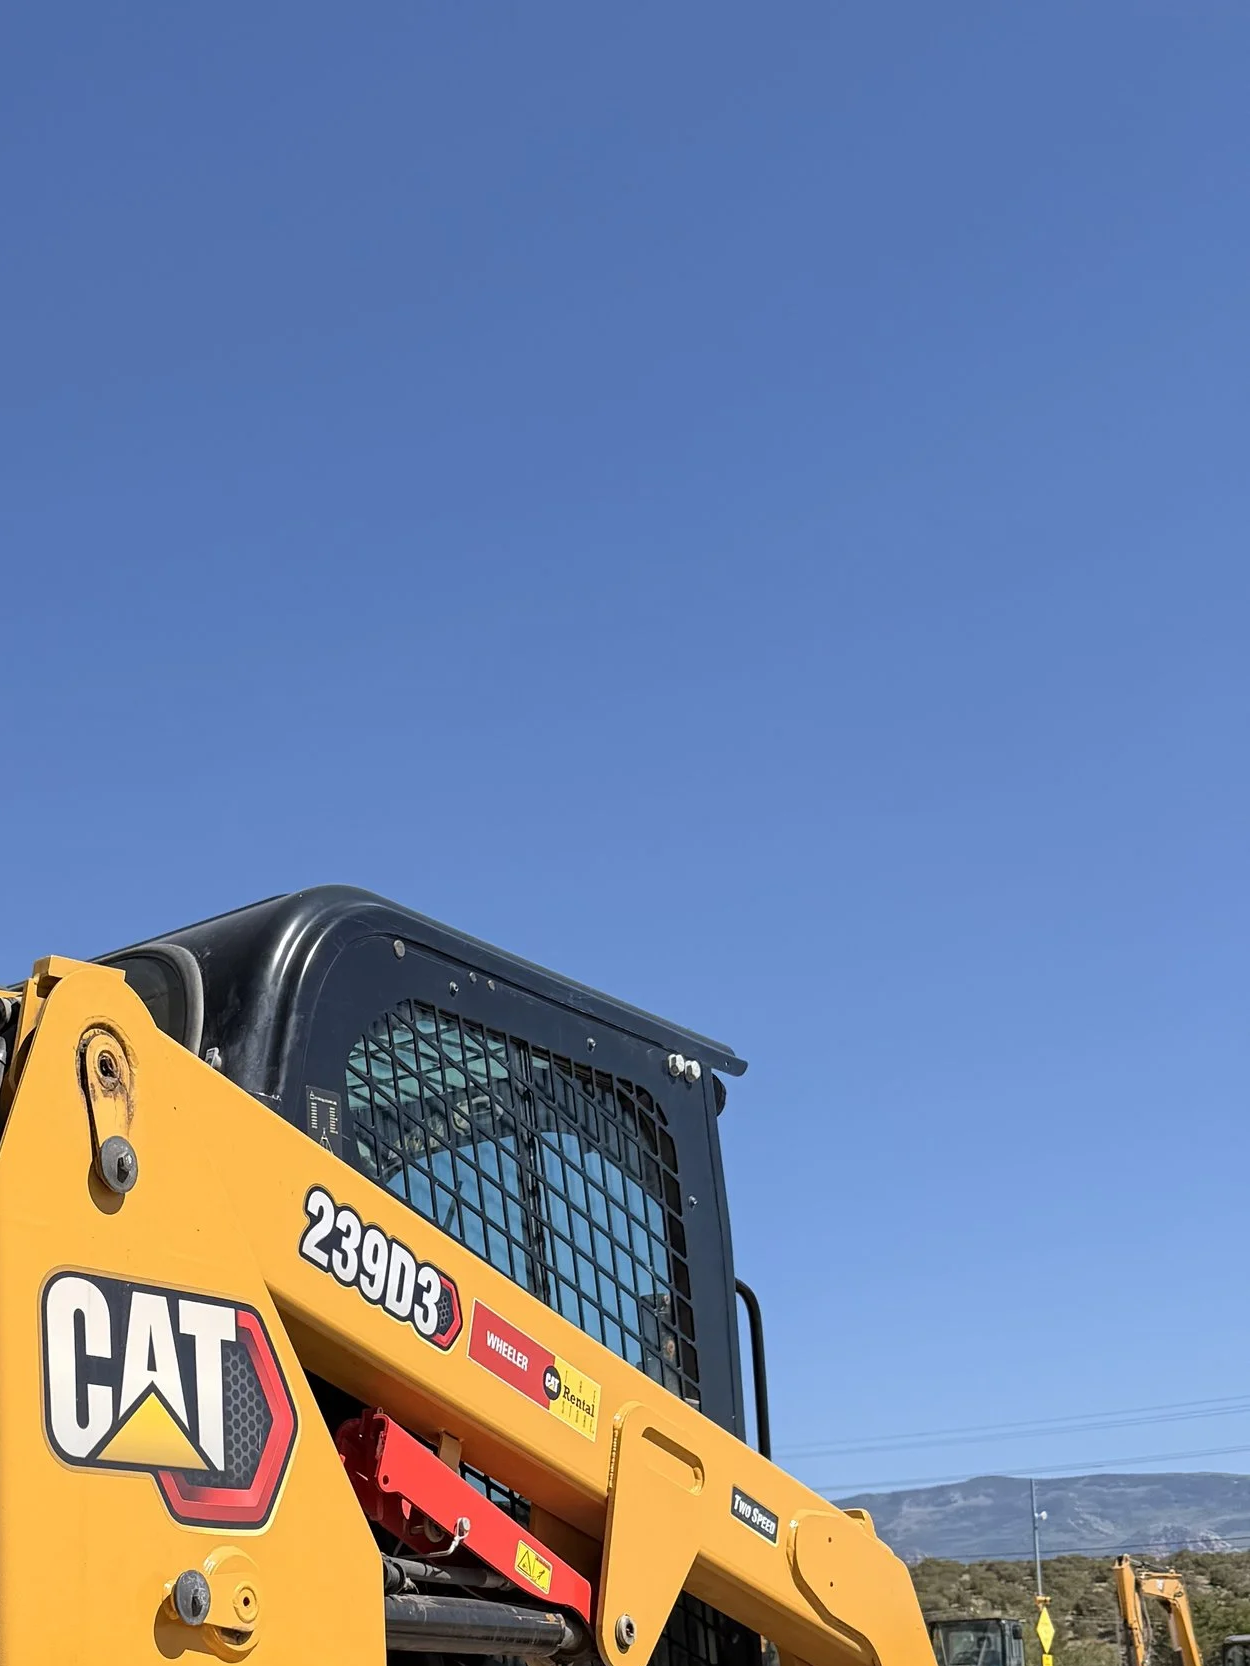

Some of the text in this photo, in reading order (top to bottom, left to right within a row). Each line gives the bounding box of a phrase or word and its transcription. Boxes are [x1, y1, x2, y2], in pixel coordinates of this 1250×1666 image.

[301, 1190, 442, 1336] 239D3
[486, 1330, 529, 1371] WHEELER
[46, 1276, 237, 1472] CAT
[545, 1372, 560, 1393] CAT
[562, 1384, 595, 1418] Rental
